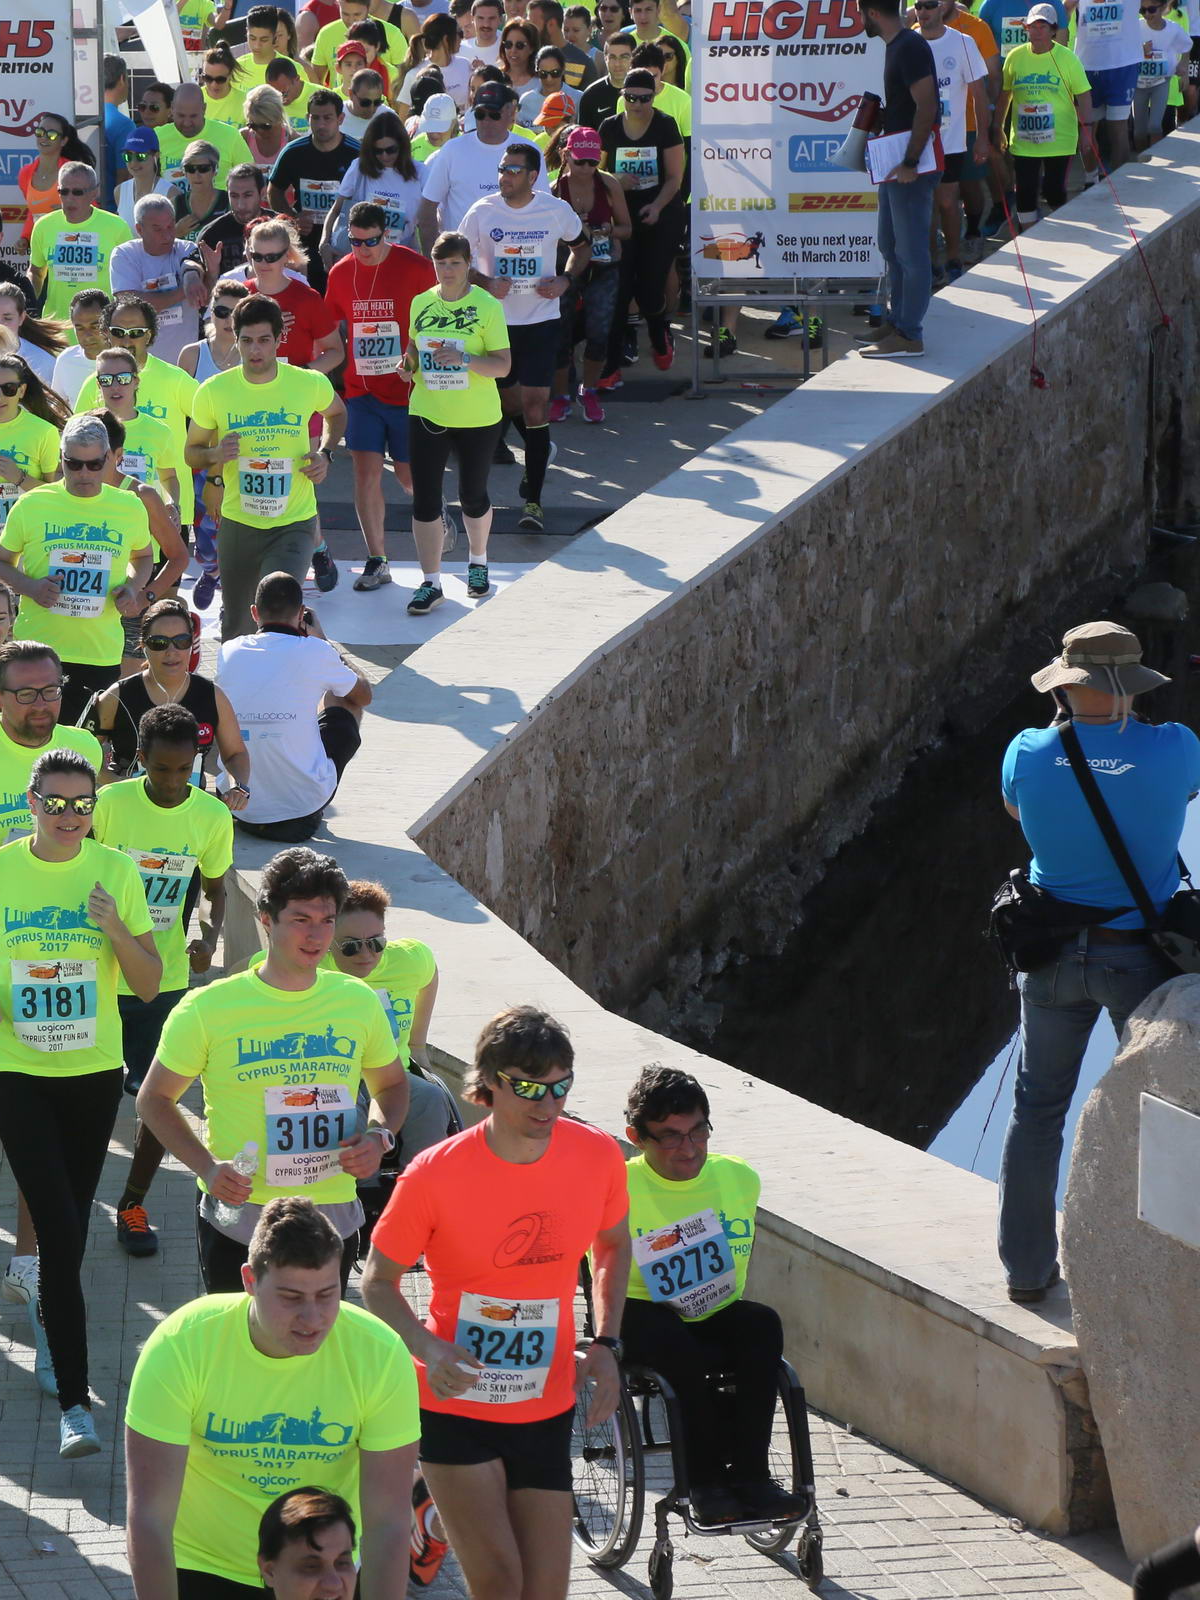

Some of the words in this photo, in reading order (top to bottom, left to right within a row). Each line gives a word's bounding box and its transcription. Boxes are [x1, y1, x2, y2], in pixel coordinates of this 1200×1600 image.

[1089, 4, 1118, 22] 3470
[1005, 29, 1031, 44] 315
[708, 45, 770, 57] SPORTS
[776, 43, 867, 56] NUTRITION
[704, 82, 836, 106] saucony
[1019, 115, 1051, 131] 3002
[479, 183, 500, 192] Logico
[741, 198, 777, 211] HUB
[800, 195, 868, 210] DHL
[776, 235, 798, 246] See
[801, 238, 820, 251] you
[823, 234, 846, 246] next
[57, 247, 94, 266] 3035
[782, 252, 799, 263] 4th
[802, 251, 836, 263] March
[839, 250, 870, 263] 2018!
[498, 258, 537, 276] 3159
[371, 301, 394, 311] HEALTH
[358, 337, 396, 358] 3227
[259, 428, 301, 437] MARATHON
[243, 473, 286, 497] 3311
[44, 542, 74, 553] CYPRUS
[76, 542, 122, 556] MARATHON
[63, 595, 91, 604] Logicom
[144, 876, 182, 904] 174
[6, 932, 42, 948] CYPRUS
[46, 931, 103, 947] MARATHON
[39, 942, 69, 952] 2017
[21, 984, 86, 1019] 3181
[37, 1022, 75, 1034] Logicom
[22, 1033, 47, 1043] CYPRUS
[48, 1033, 62, 1042] 5KM
[63, 1032, 76, 1041] FUN
[77, 1031, 89, 1040] RUN
[48, 1043, 64, 1052] 2017
[237, 1063, 287, 1082] CYPRUS
[289, 1061, 351, 1074] MARATHON
[283, 1072, 317, 1085] 2017
[276, 1112, 345, 1152] 3161
[293, 1153, 331, 1166] Logicom
[274, 1167, 302, 1177] CYPRUS
[303, 1166, 318, 1176] 5KM
[318, 1163, 330, 1173] FUN
[303, 1174, 318, 1185] 2017
[651, 1240, 725, 1297] 3273
[679, 1282, 716, 1304] Logicom
[691, 1297, 706, 1310] 5KM
[706, 1291, 718, 1302] FUN
[718, 1283, 731, 1296] RUN
[694, 1304, 708, 1317] 2017
[466, 1325, 545, 1366] 3243
[478, 1370, 523, 1382] Logicom
[489, 1382, 507, 1393] 5KM
[508, 1382, 523, 1393] FUN
[523, 1381, 537, 1391] RUN
[489, 1393, 507, 1403] 2017
